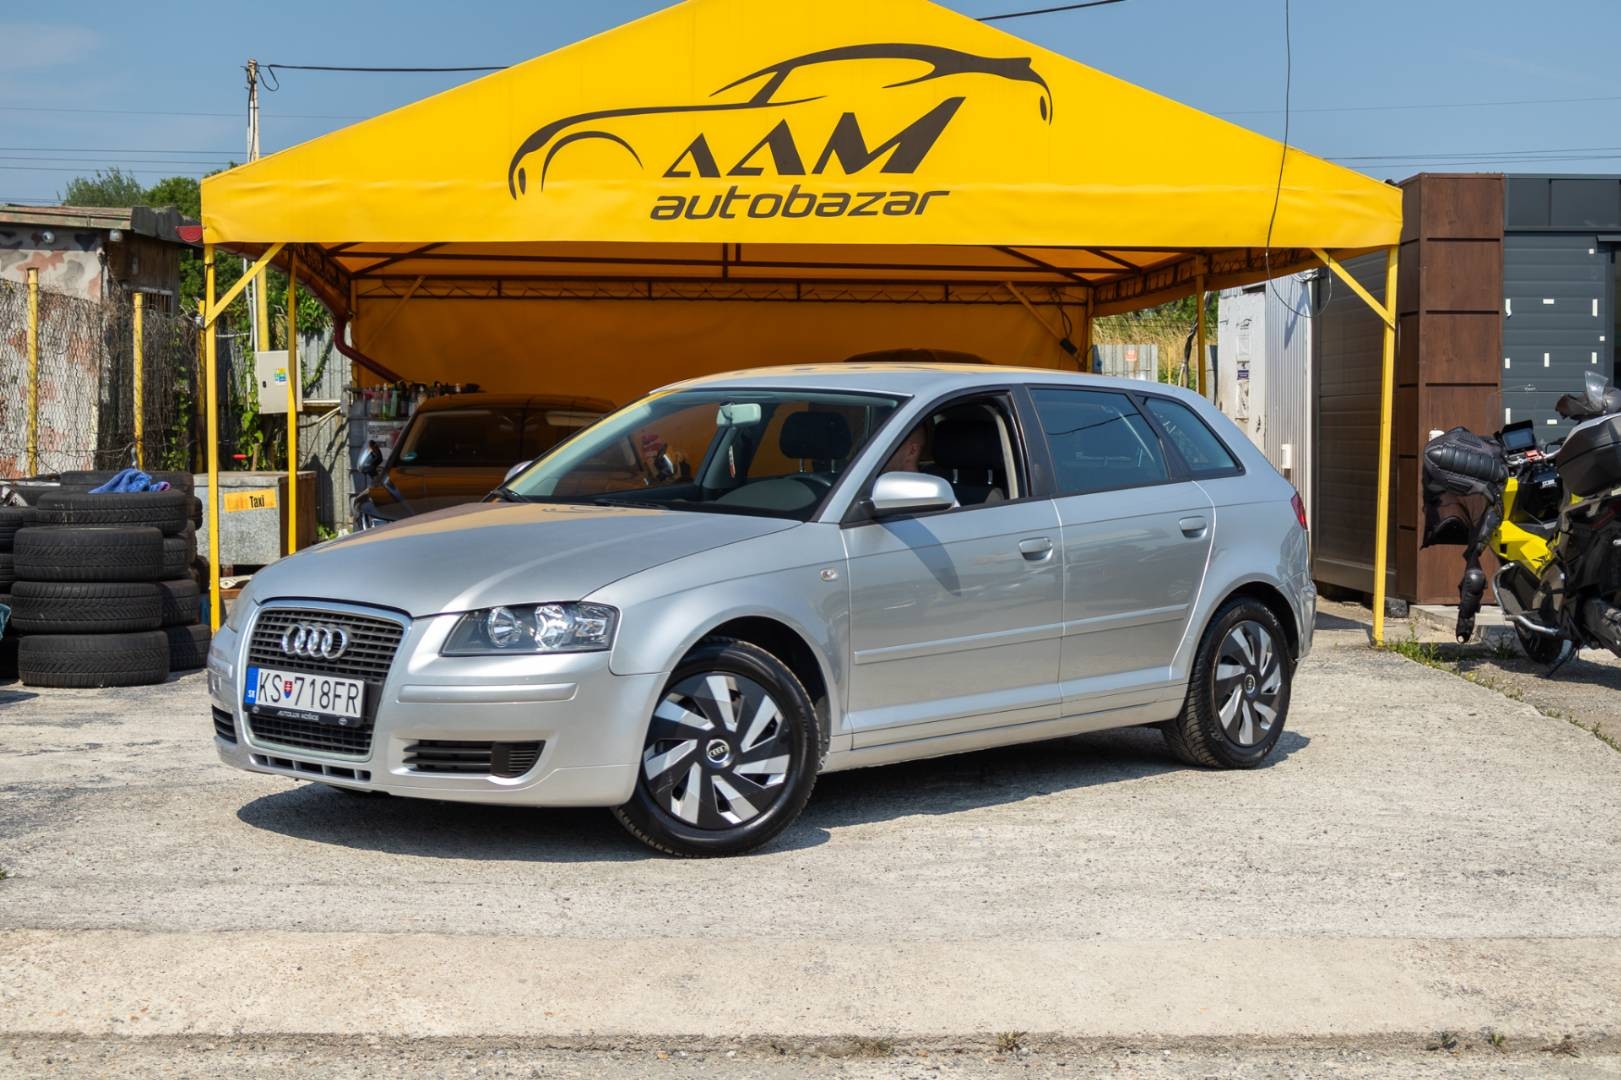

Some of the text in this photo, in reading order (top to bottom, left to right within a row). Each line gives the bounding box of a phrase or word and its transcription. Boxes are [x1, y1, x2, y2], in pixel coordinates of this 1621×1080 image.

[662, 96, 966, 178] AAM
[649, 184, 950, 221] autobazar
[249, 495, 265, 508] Taxi
[259, 671, 359, 714] KS 718FR
